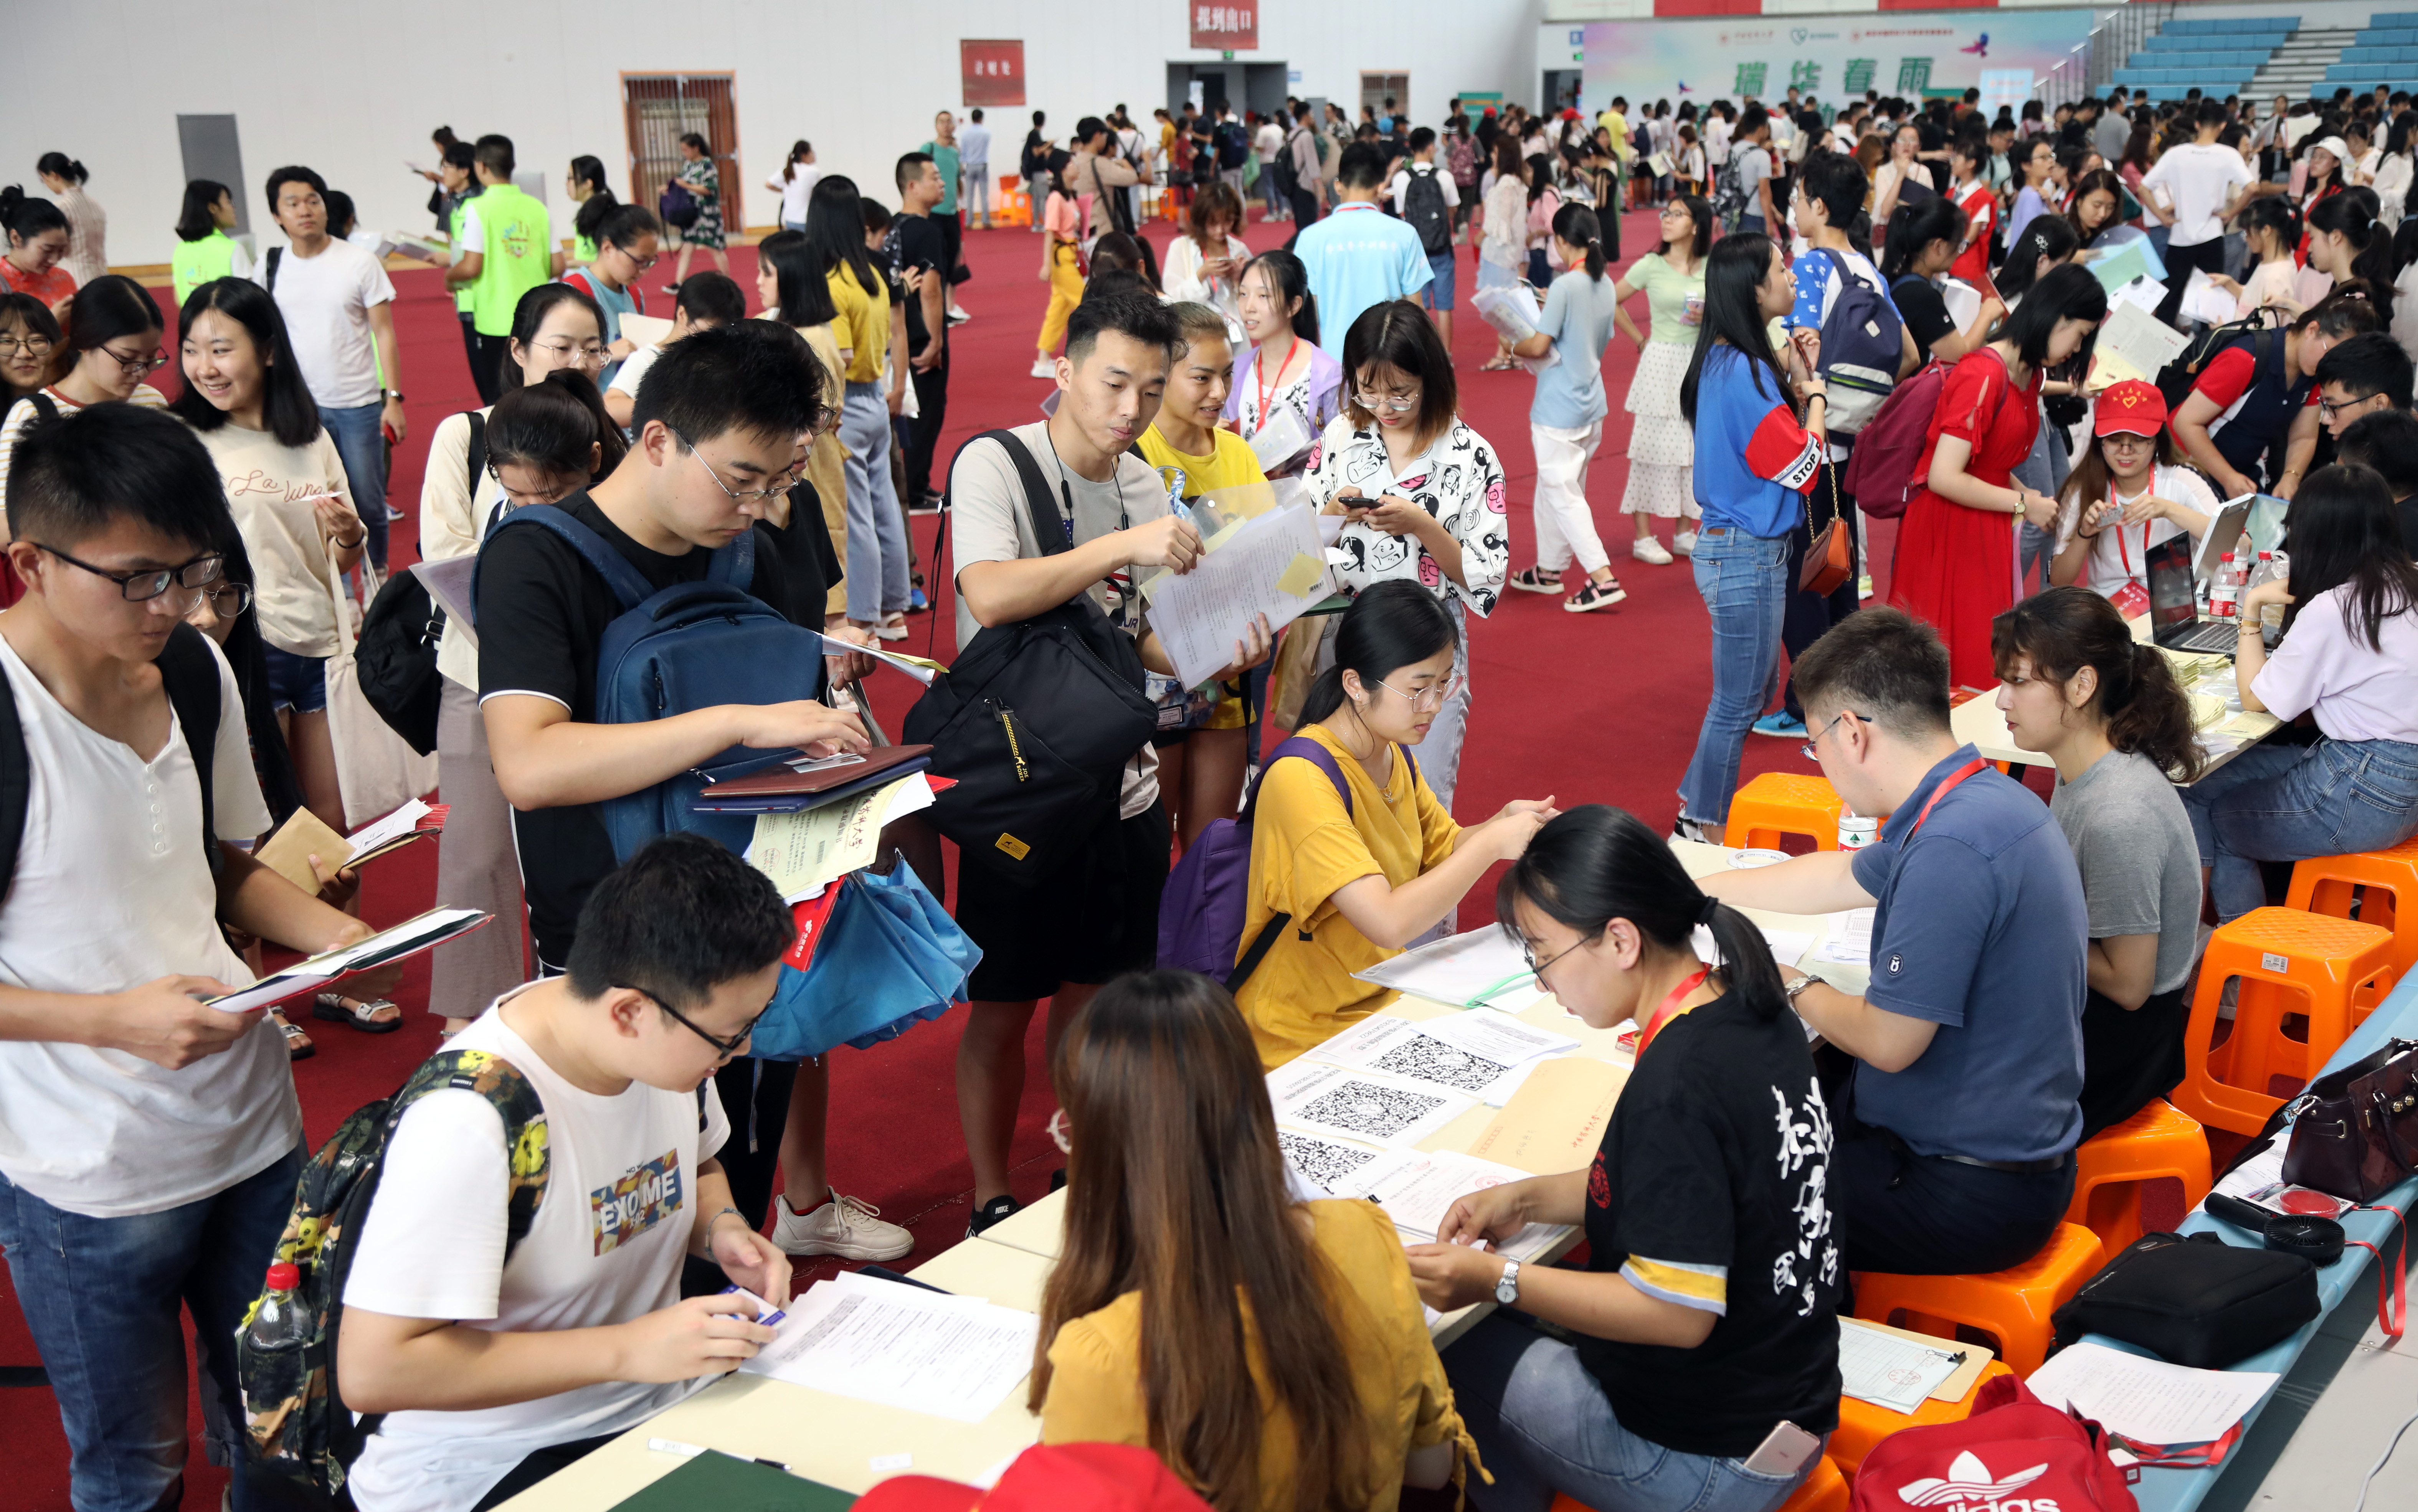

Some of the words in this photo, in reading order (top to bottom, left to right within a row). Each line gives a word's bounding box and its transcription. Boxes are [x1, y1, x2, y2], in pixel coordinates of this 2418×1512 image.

[1196, 5, 1252, 33] 报到出口
[1793, 454, 1816, 483] STOP
[228, 470, 284, 496] La
[1016, 765, 1025, 782] BOXER
